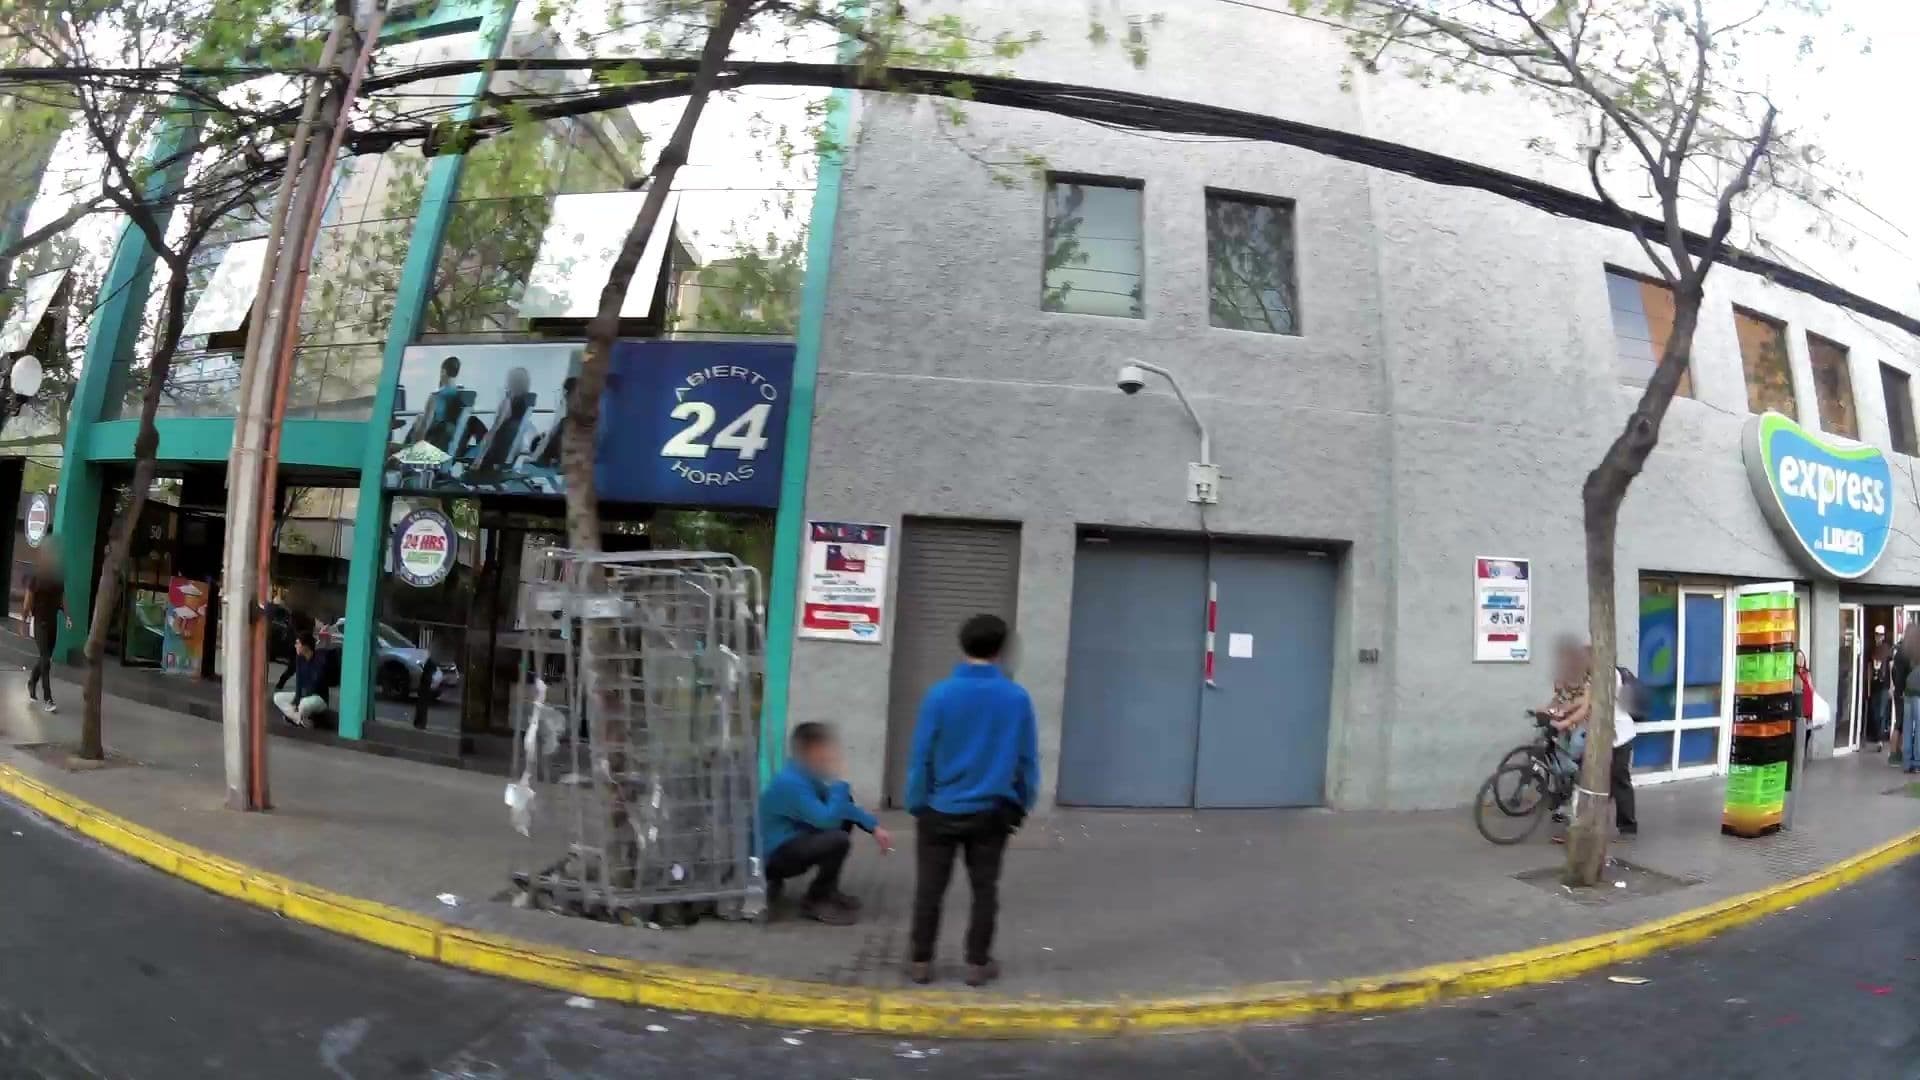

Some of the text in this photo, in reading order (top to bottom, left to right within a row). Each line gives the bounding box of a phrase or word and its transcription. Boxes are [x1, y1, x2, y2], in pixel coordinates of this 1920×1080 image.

[675, 365, 778, 403] ABIERTO
[660, 401, 773, 461] 24
[671, 460, 755, 487] HORAS
[1779, 455, 1886, 516] express
[403, 533, 446, 552] 24 HRS
[1823, 526, 1865, 557] LIDER
